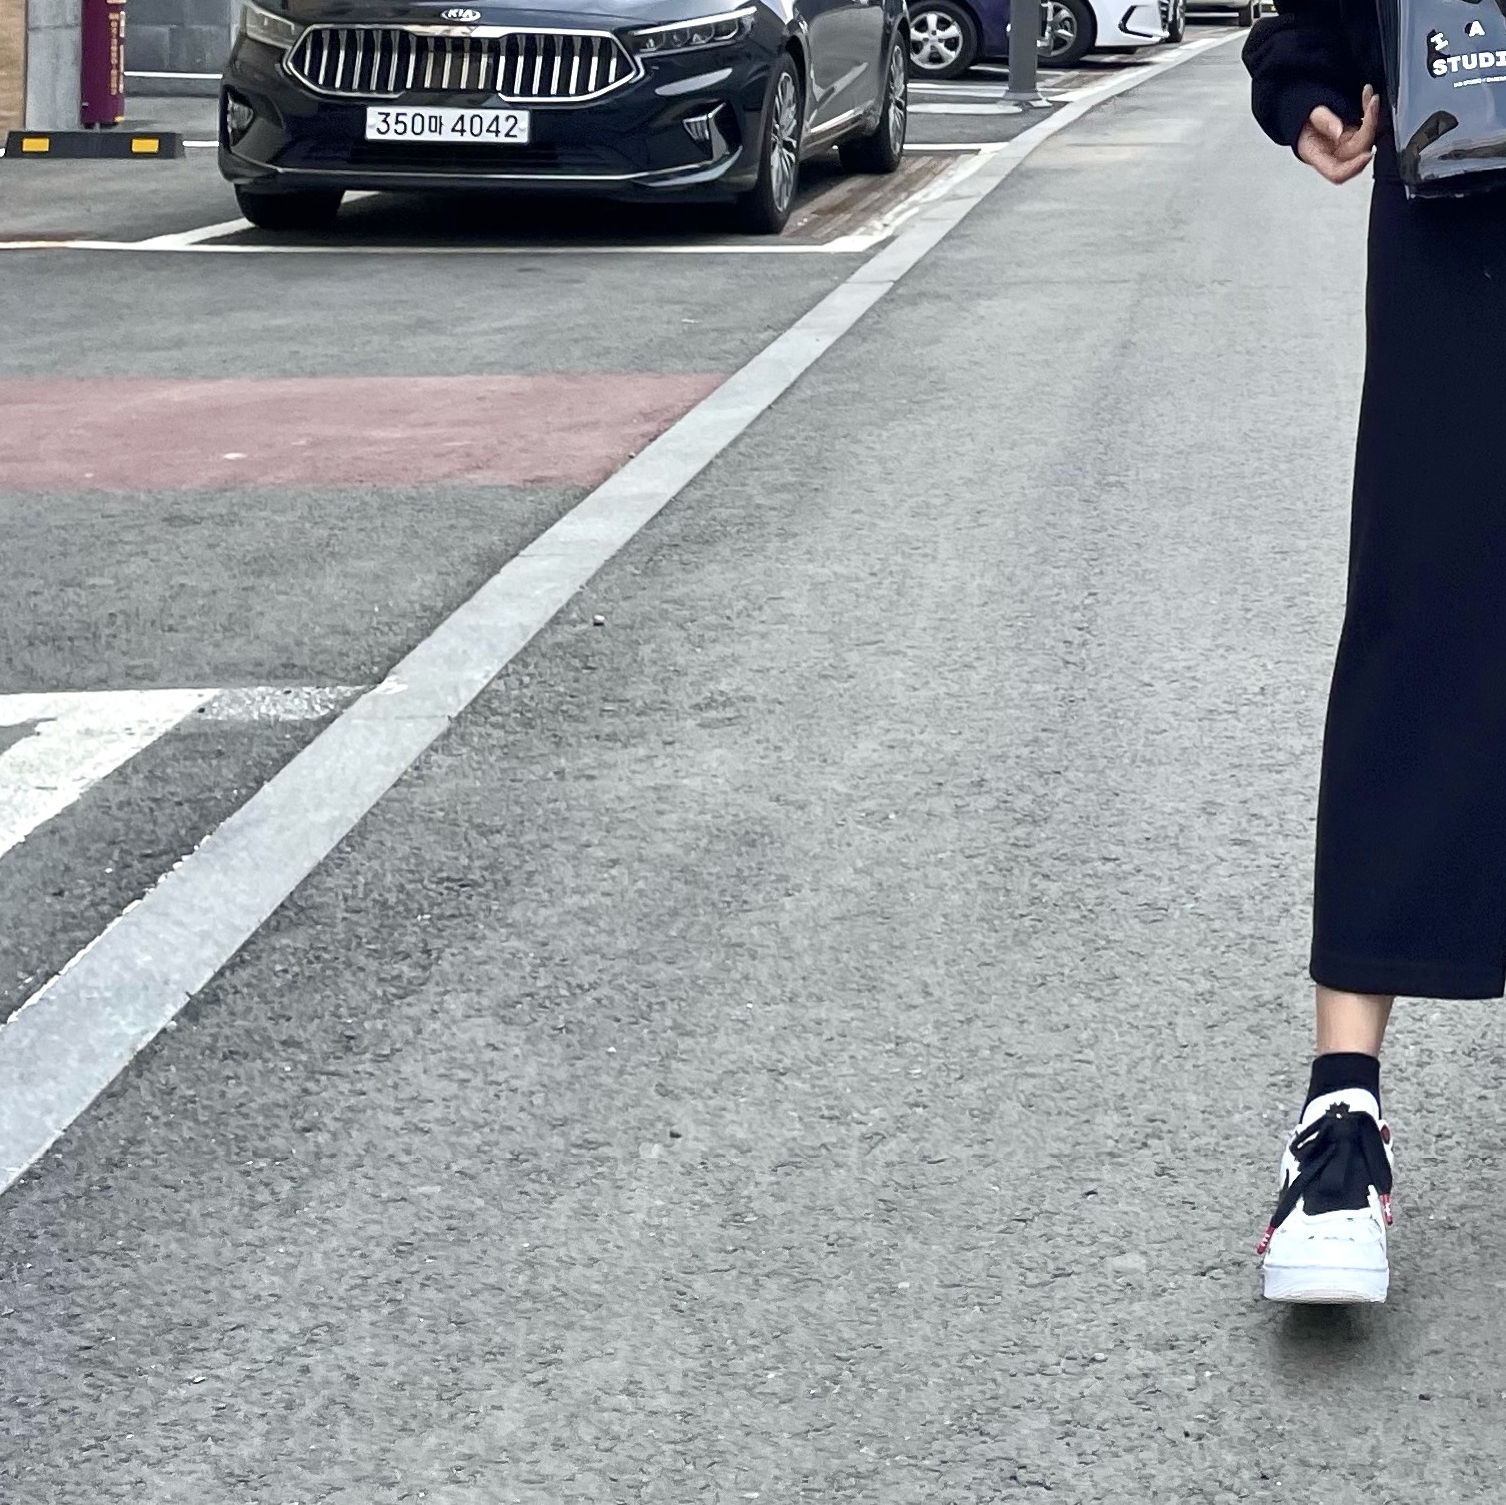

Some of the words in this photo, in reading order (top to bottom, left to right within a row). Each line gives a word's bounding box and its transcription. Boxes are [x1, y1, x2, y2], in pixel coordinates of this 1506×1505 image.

[446, 8, 476, 19] KIA
[376, 111, 444, 137] 350마
[450, 113, 519, 139] 4042
